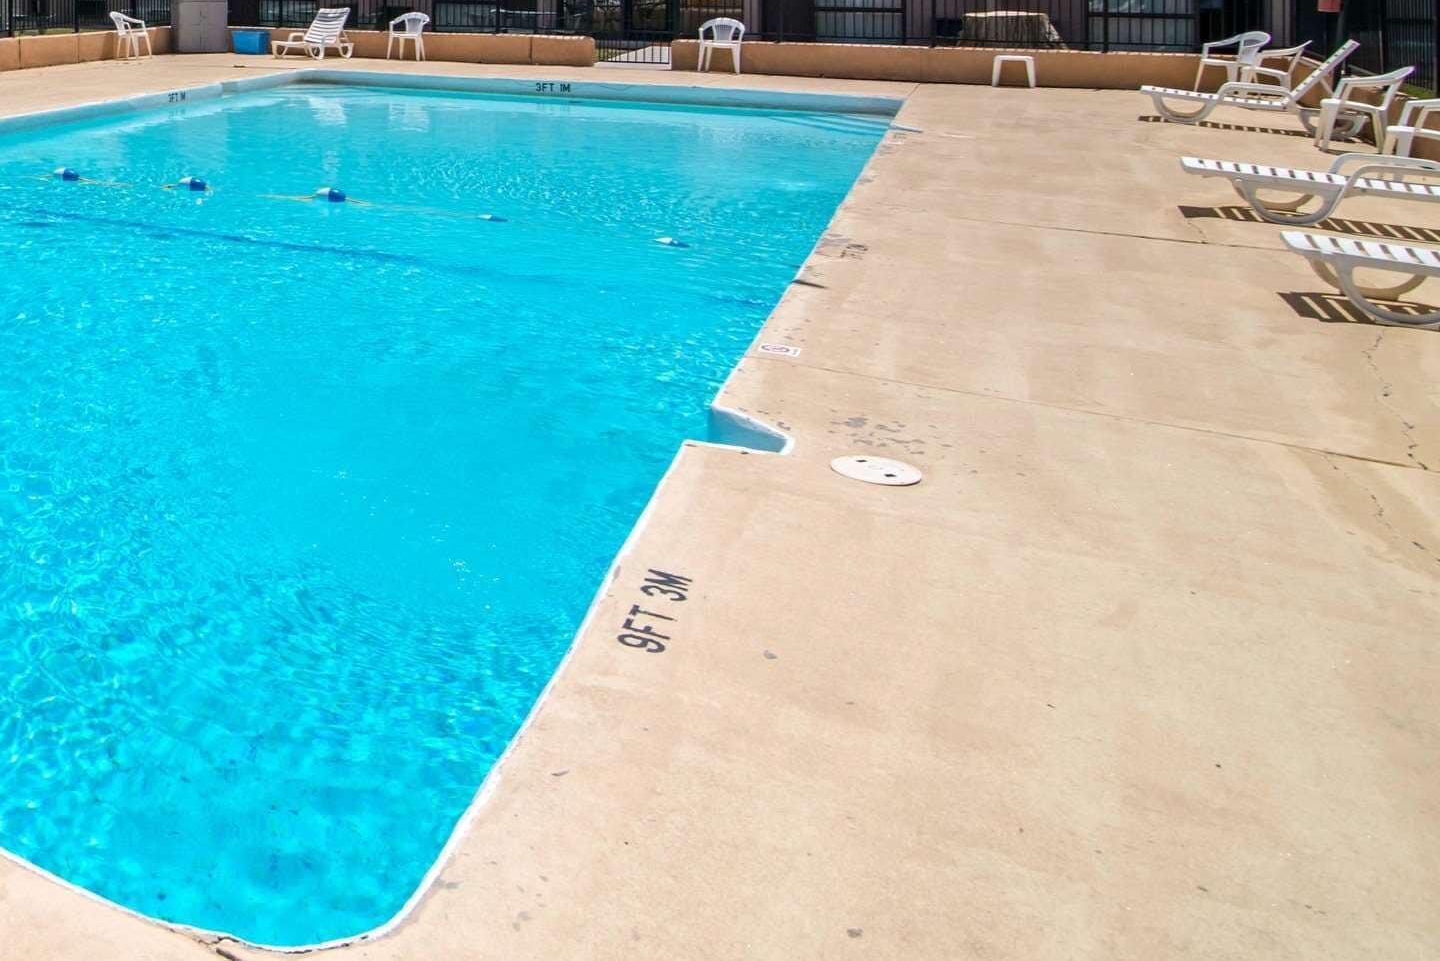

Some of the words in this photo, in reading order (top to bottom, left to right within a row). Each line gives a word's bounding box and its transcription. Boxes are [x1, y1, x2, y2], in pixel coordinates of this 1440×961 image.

[535, 82, 555, 93] 3FT
[639, 568, 693, 602] 3M
[617, 604, 678, 654] 9FT
